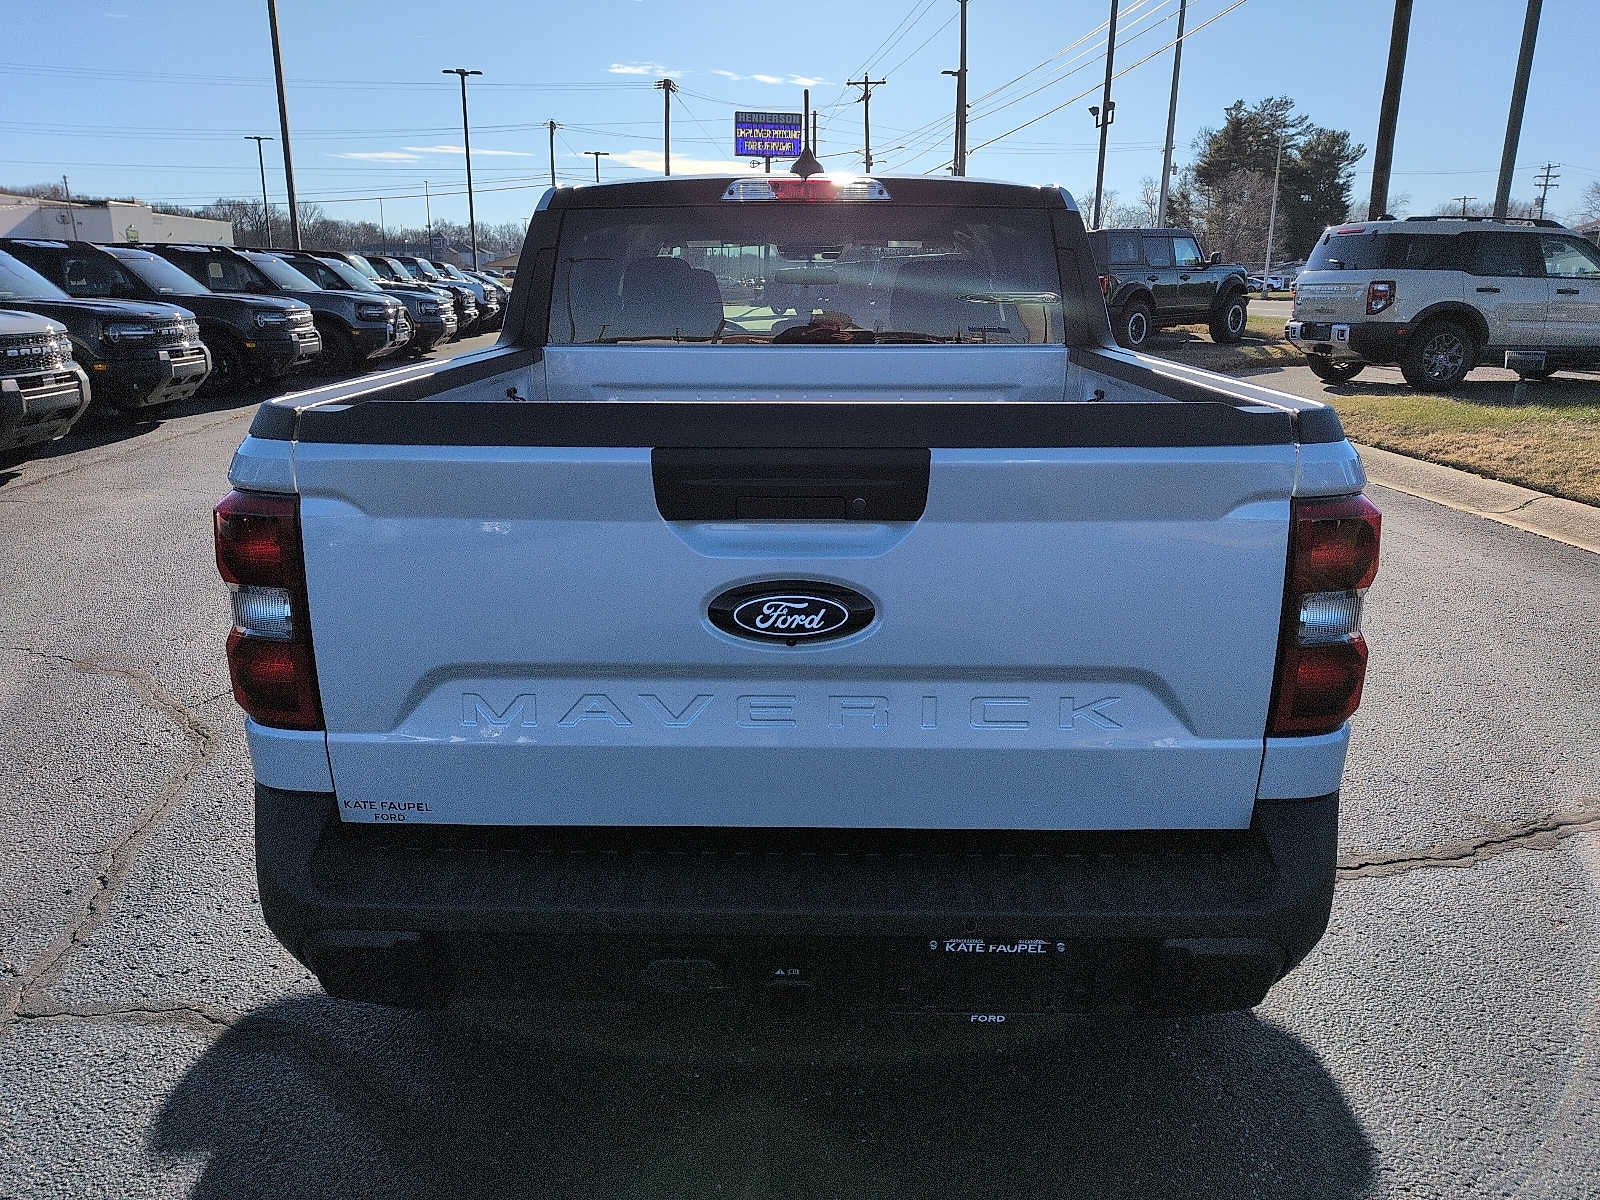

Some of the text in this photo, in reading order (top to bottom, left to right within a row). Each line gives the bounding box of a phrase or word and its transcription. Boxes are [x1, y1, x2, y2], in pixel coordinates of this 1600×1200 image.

[738, 113, 801, 124] HENDERSON
[772, 129, 801, 139] PRICING
[744, 141, 758, 151] FOR
[755, 601, 827, 629] Ford
[459, 692, 1125, 730] MAVERICK
[343, 800, 433, 812] KATE FAUPEL
[374, 813, 406, 822] FORD
[945, 942, 1047, 954] KATE FAUPEL
[970, 1015, 1006, 1023] FORD
